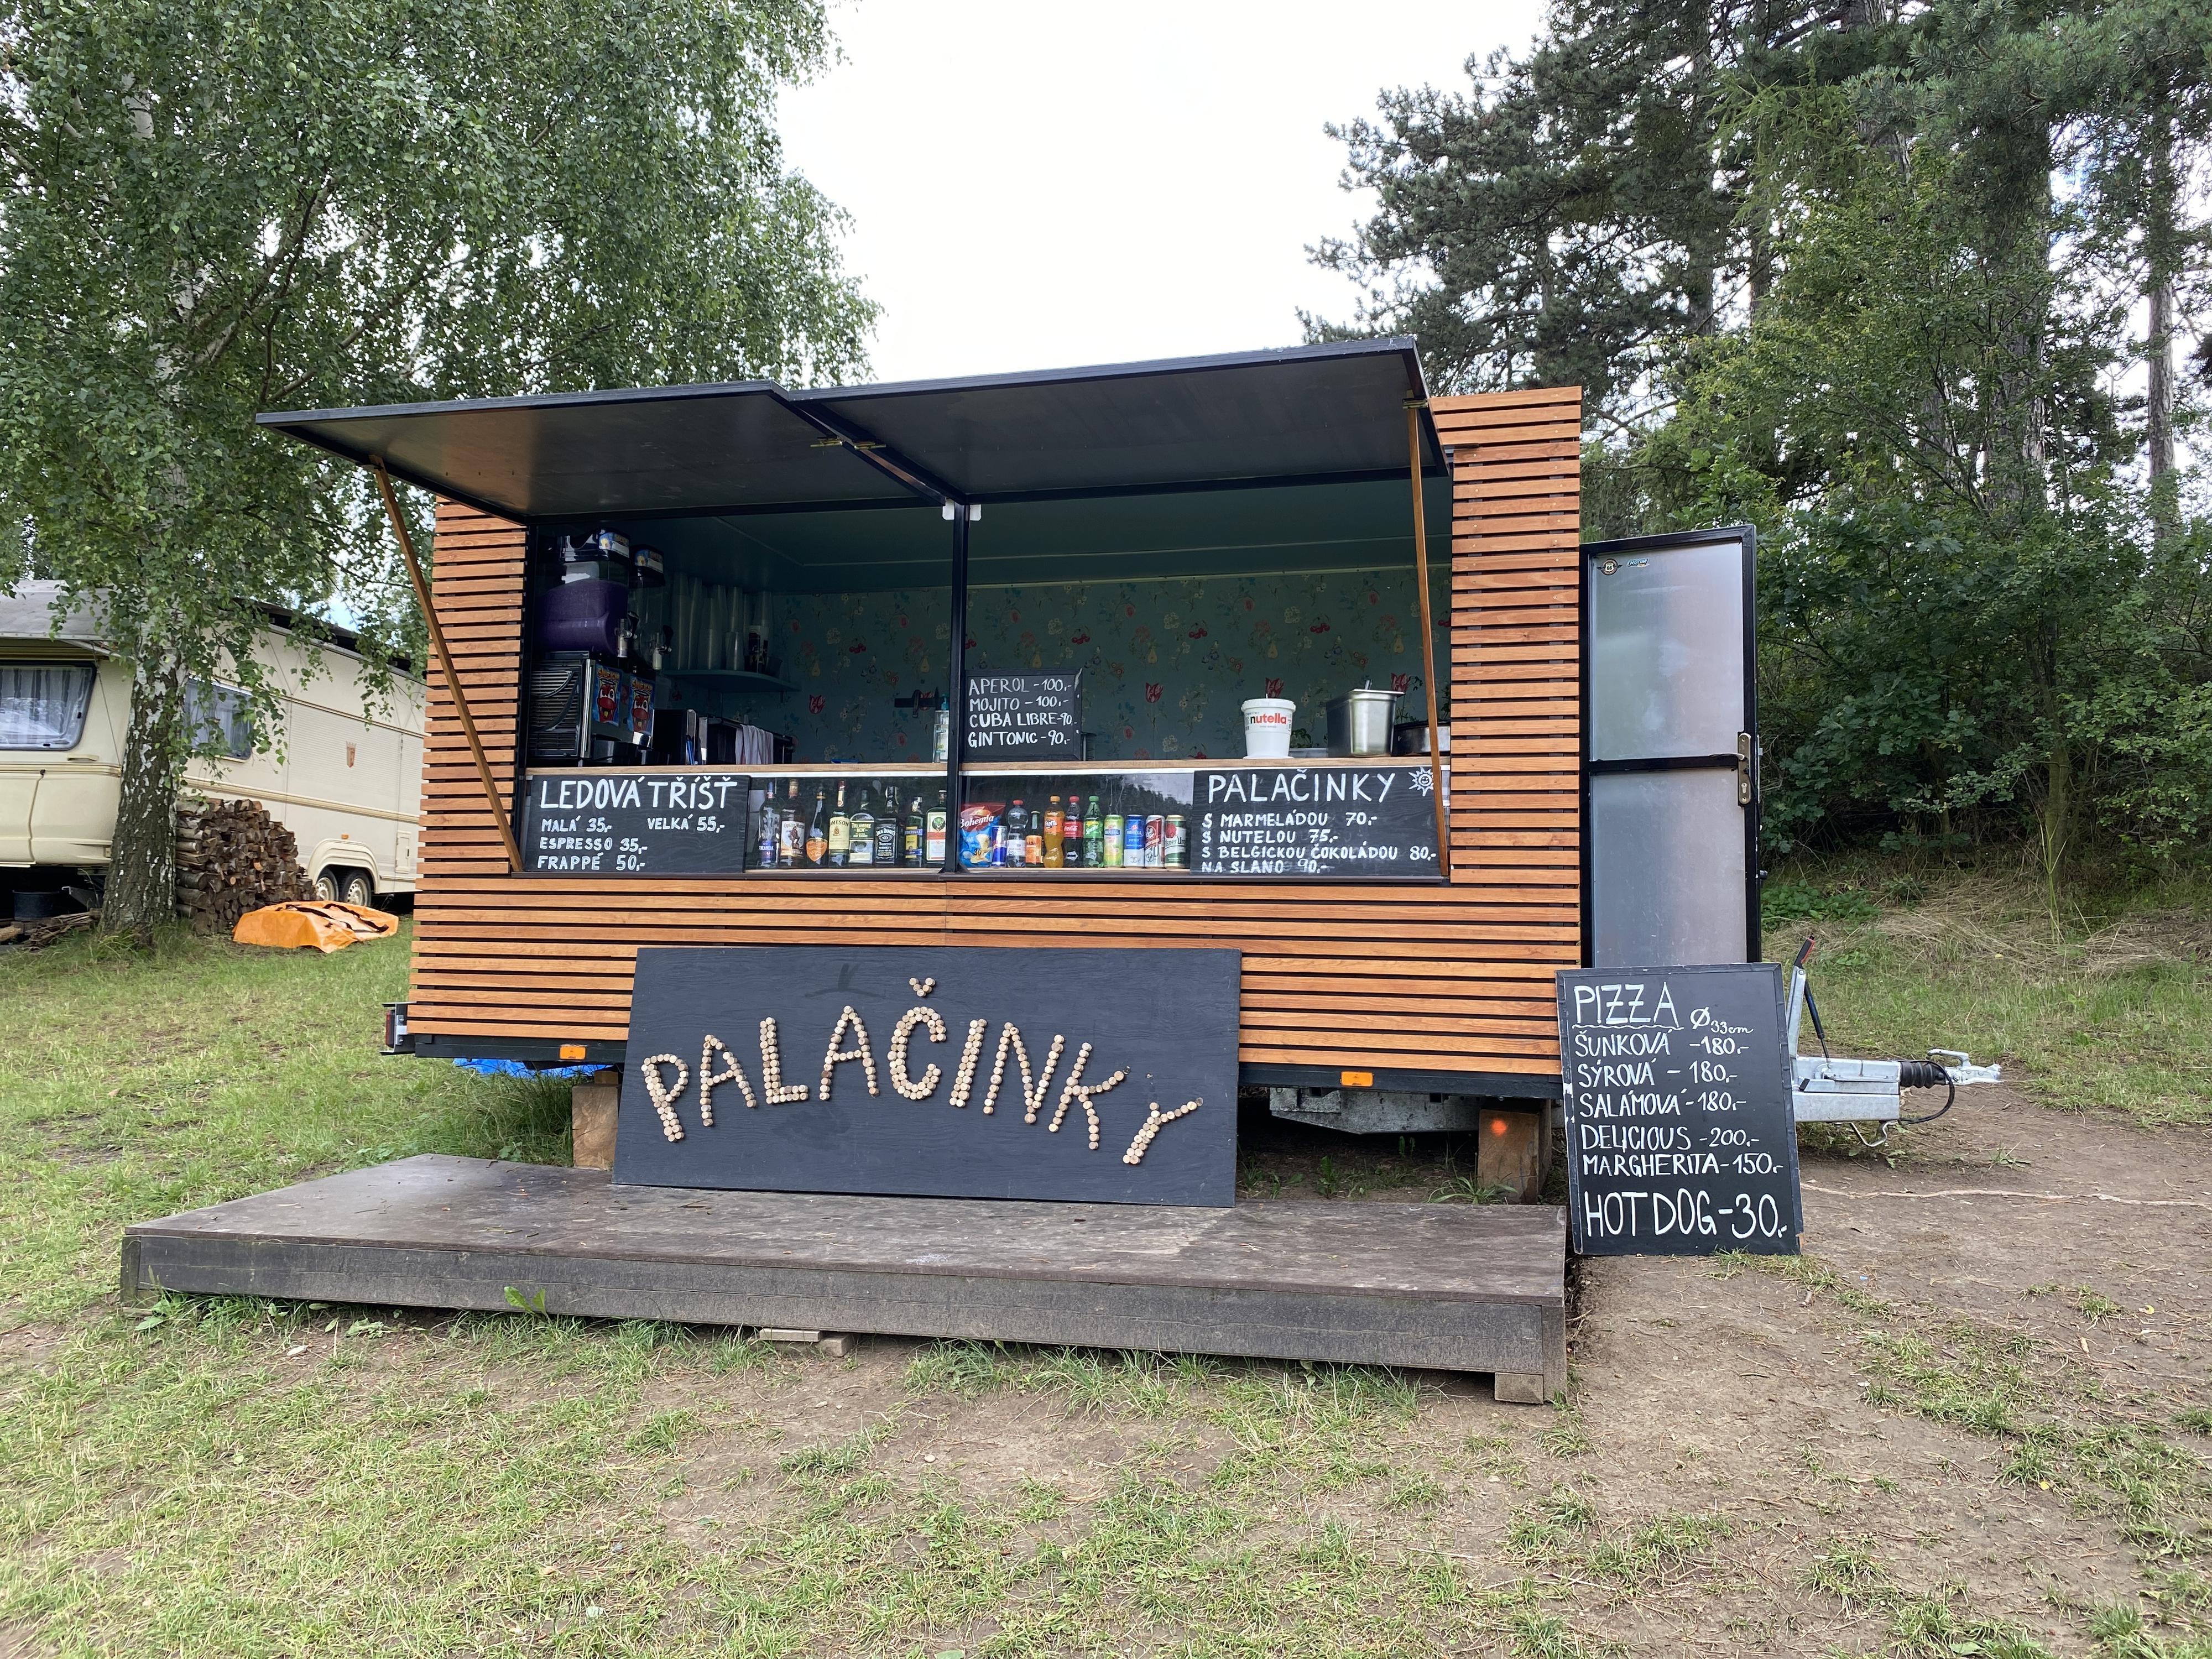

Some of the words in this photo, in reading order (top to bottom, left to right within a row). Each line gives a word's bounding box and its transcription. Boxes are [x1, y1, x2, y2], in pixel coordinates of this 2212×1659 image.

[969, 678, 1030, 696] APEROL
[969, 697, 1020, 712] MOJITO
[969, 712, 1011, 728] CUBA
[1250, 713, 1286, 724] nutella
[540, 776, 645, 809] LEDOVÁ
[648, 776, 737, 810] TŘÍŠŤ
[1208, 769, 1396, 804] PALAČINKY
[541, 815, 581, 832] MALÁ
[648, 814, 693, 830] VELKÁ
[1202, 813, 1213, 828] S
[1220, 809, 1327, 827] MARMELÁDOU
[540, 837, 613, 851] ESPRESSO
[1202, 831, 1212, 843] S
[1220, 830, 1296, 843] NUTELOU
[1202, 846, 1211, 858] S
[1218, 846, 1306, 858] BELGICKOU
[1311, 841, 1397, 860] ČOKOLÁDOU
[538, 852, 603, 870] FRAPPÉ
[1202, 862, 1223, 873] NA
[1230, 860, 1284, 873] SLANO
[1574, 982, 1679, 1027] PIZZA
[1575, 1029, 1672, 1057] ŠUNKOVÁ
[641, 977, 1204, 1166] PALAČINKY
[1578, 1058, 1657, 1088] SÝROVÁ
[1579, 1088, 1687, 1118] SALÁMOVÁ
[1580, 1124, 1691, 1153] DELICIOUS
[1584, 1191, 1648, 1238] HOT
